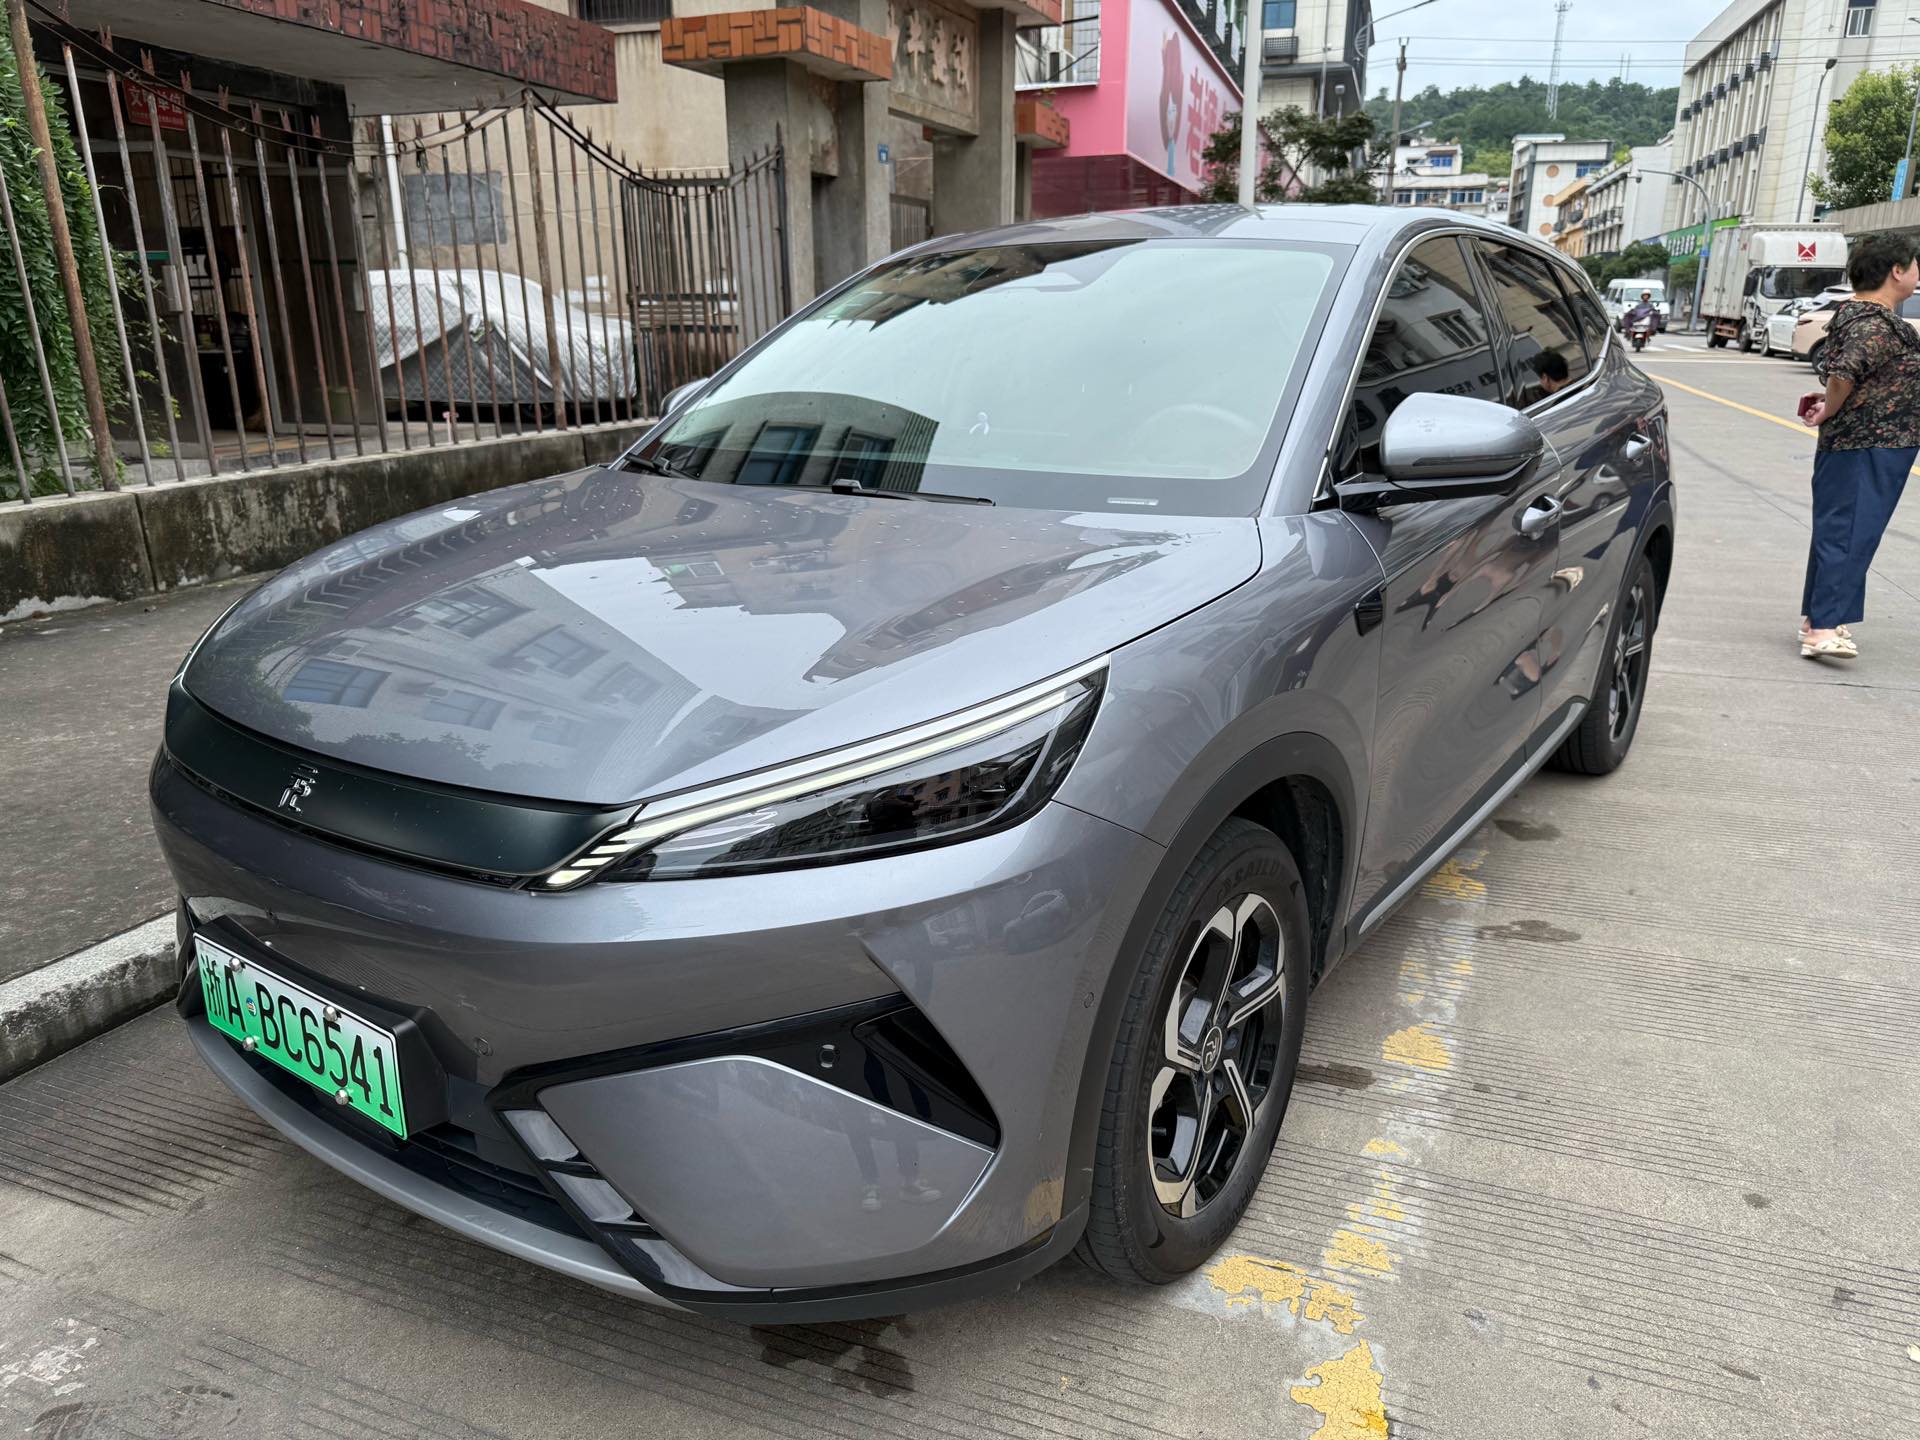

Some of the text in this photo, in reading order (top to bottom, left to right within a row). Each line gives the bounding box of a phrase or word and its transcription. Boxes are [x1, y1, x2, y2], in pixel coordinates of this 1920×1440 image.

[129, 85, 184, 114] 文单位
[254, 981, 395, 1119] BC6541
